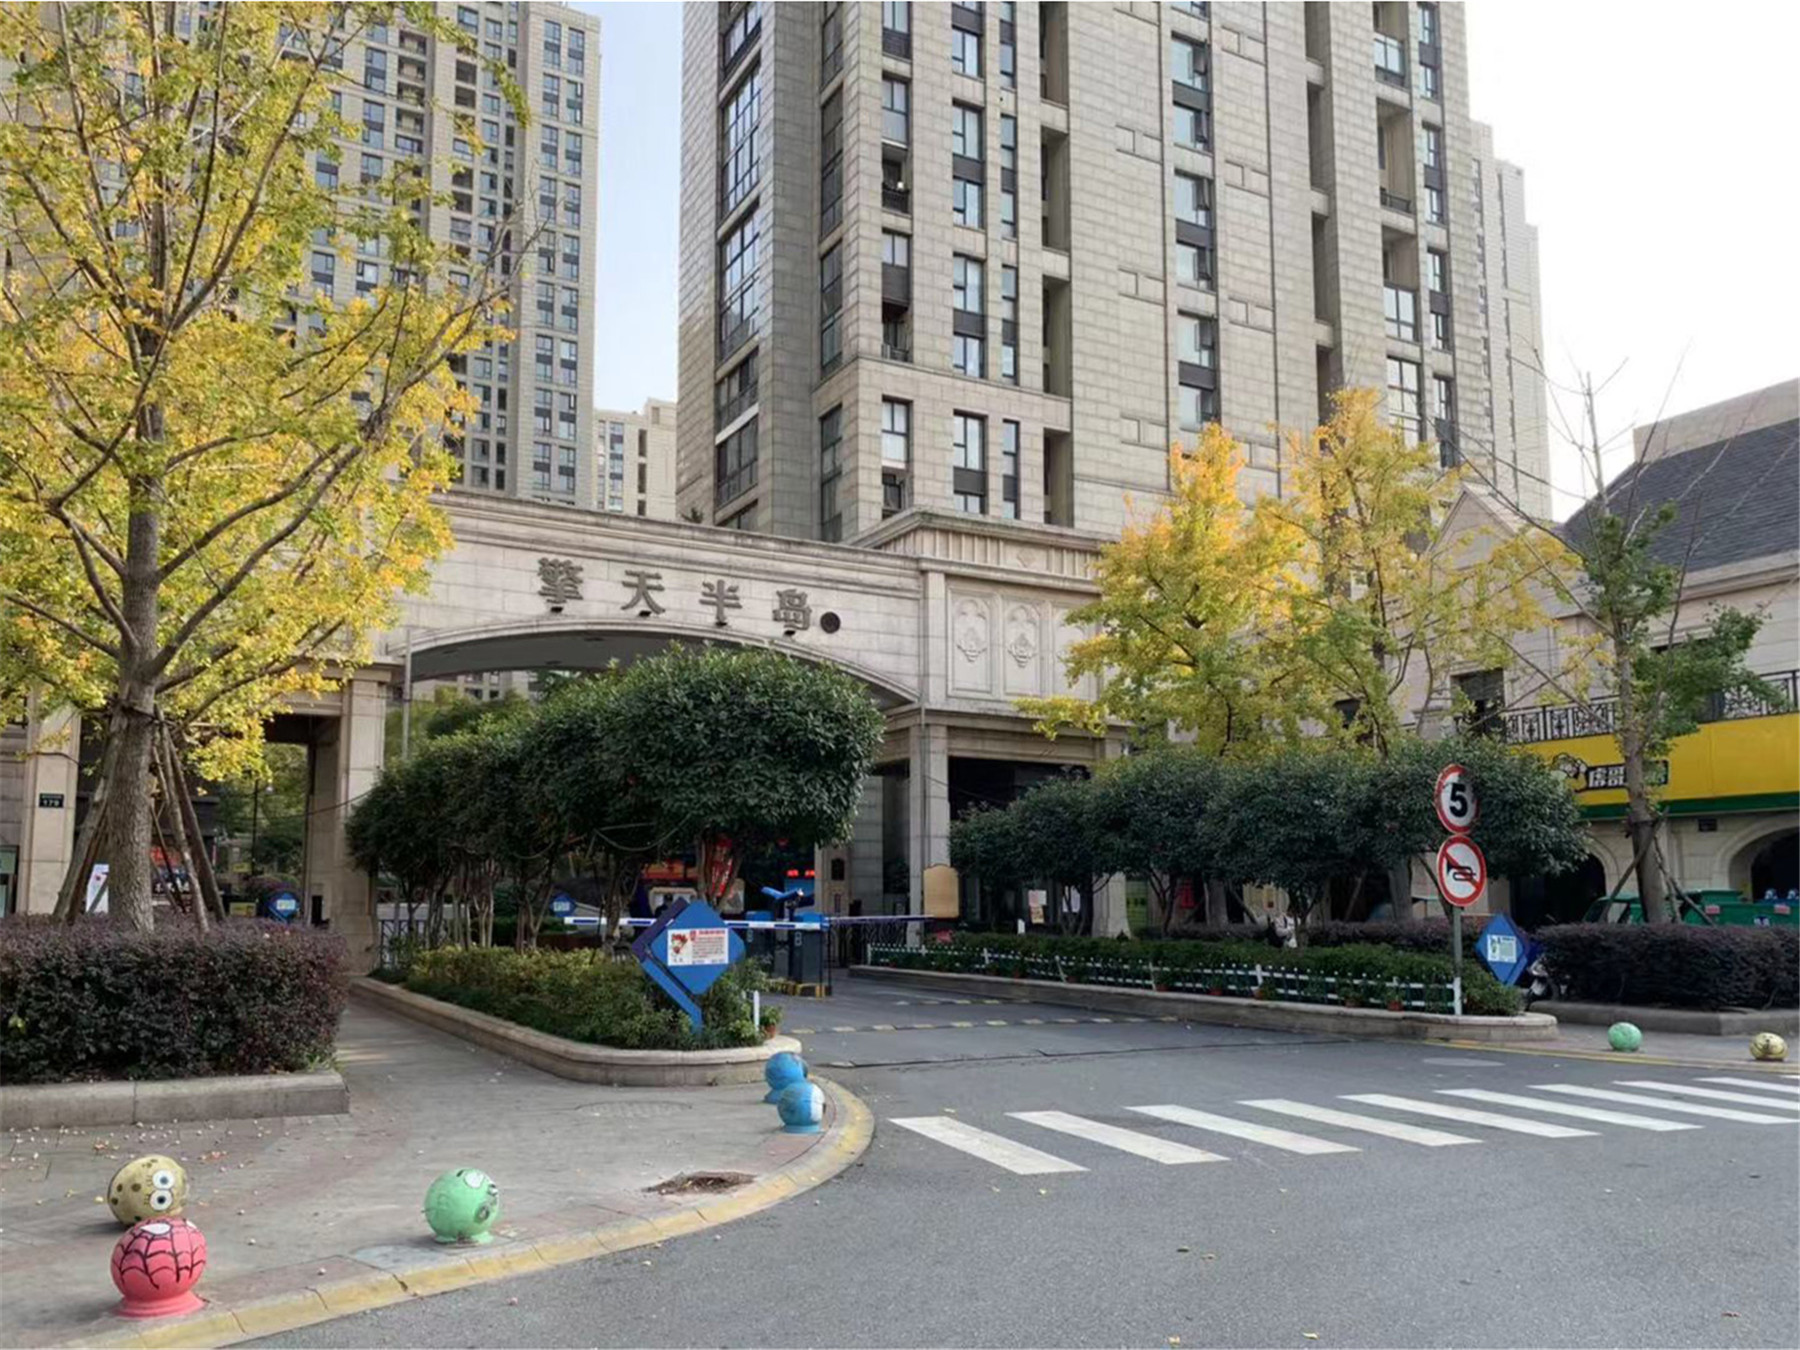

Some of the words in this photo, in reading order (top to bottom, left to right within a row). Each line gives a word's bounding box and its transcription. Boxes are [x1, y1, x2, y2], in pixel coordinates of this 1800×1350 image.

[537, 557, 812, 631] 擎天半岛
[1449, 782, 1468, 818] 5
